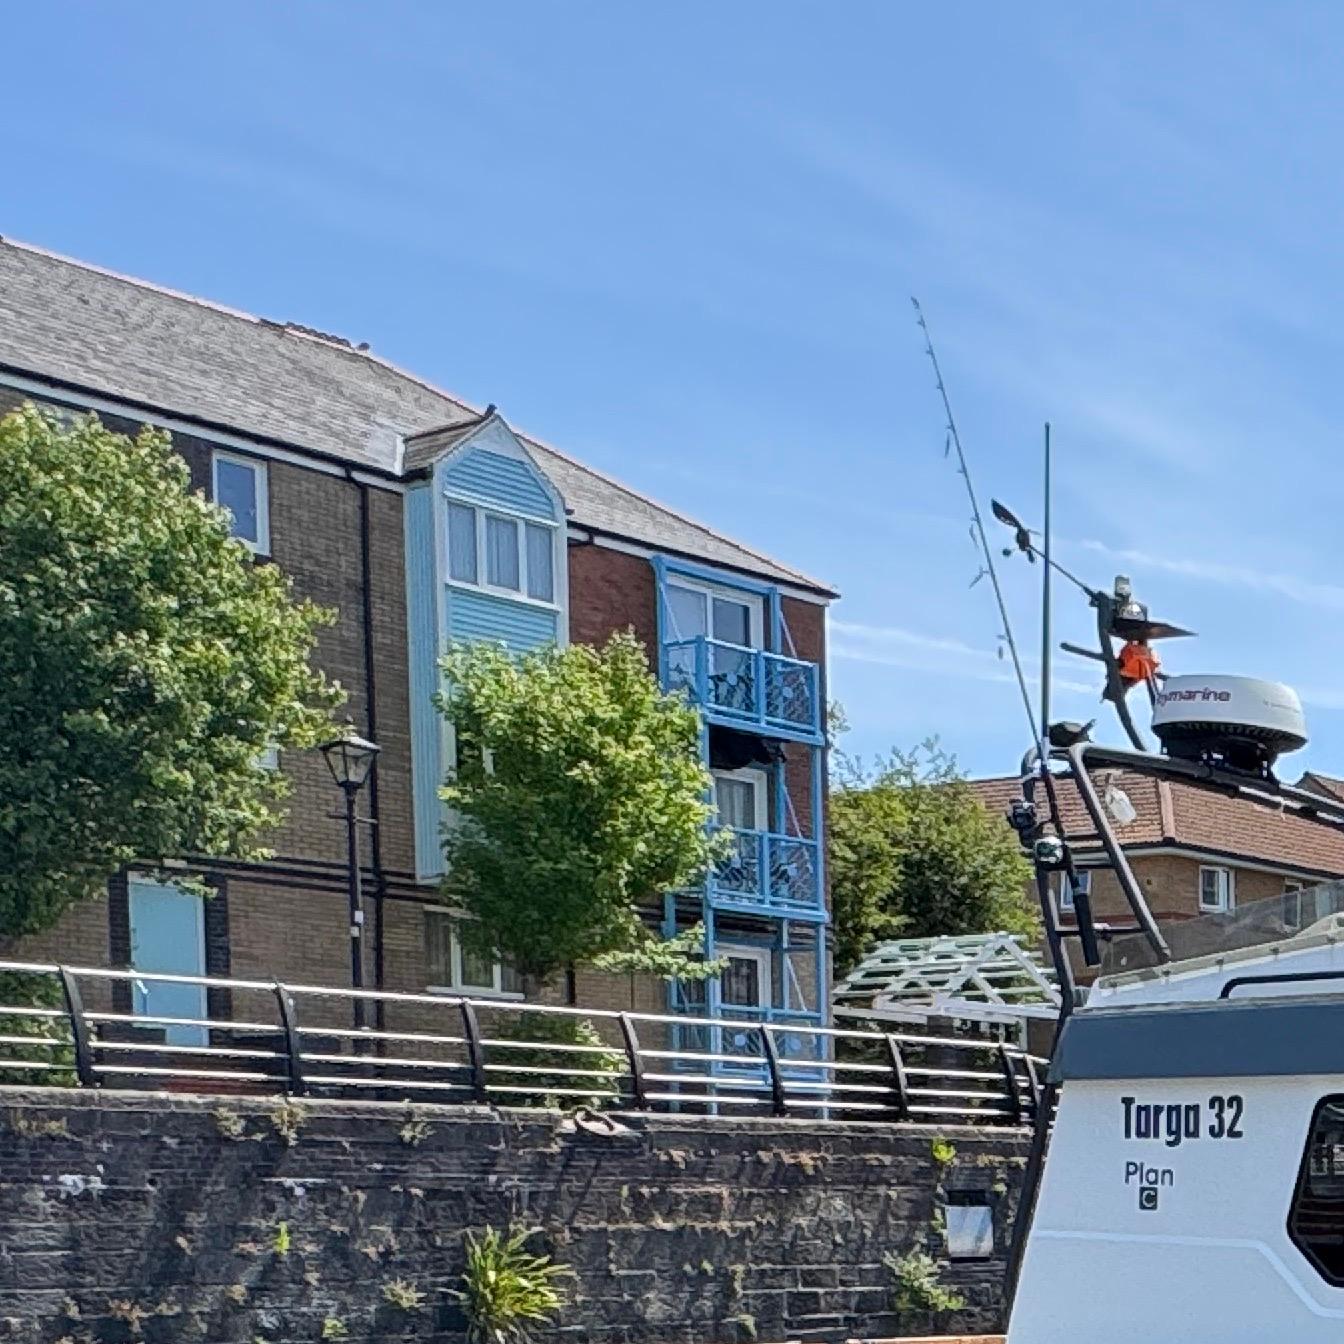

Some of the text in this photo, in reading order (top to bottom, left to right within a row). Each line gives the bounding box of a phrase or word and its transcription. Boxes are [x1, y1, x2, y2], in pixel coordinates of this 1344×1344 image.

[1157, 687, 1231, 706] ymarine
[1121, 1095, 1243, 1147] Targa 32
[1125, 1161, 1174, 1187] Plan
[1141, 1189, 1157, 1208] C
